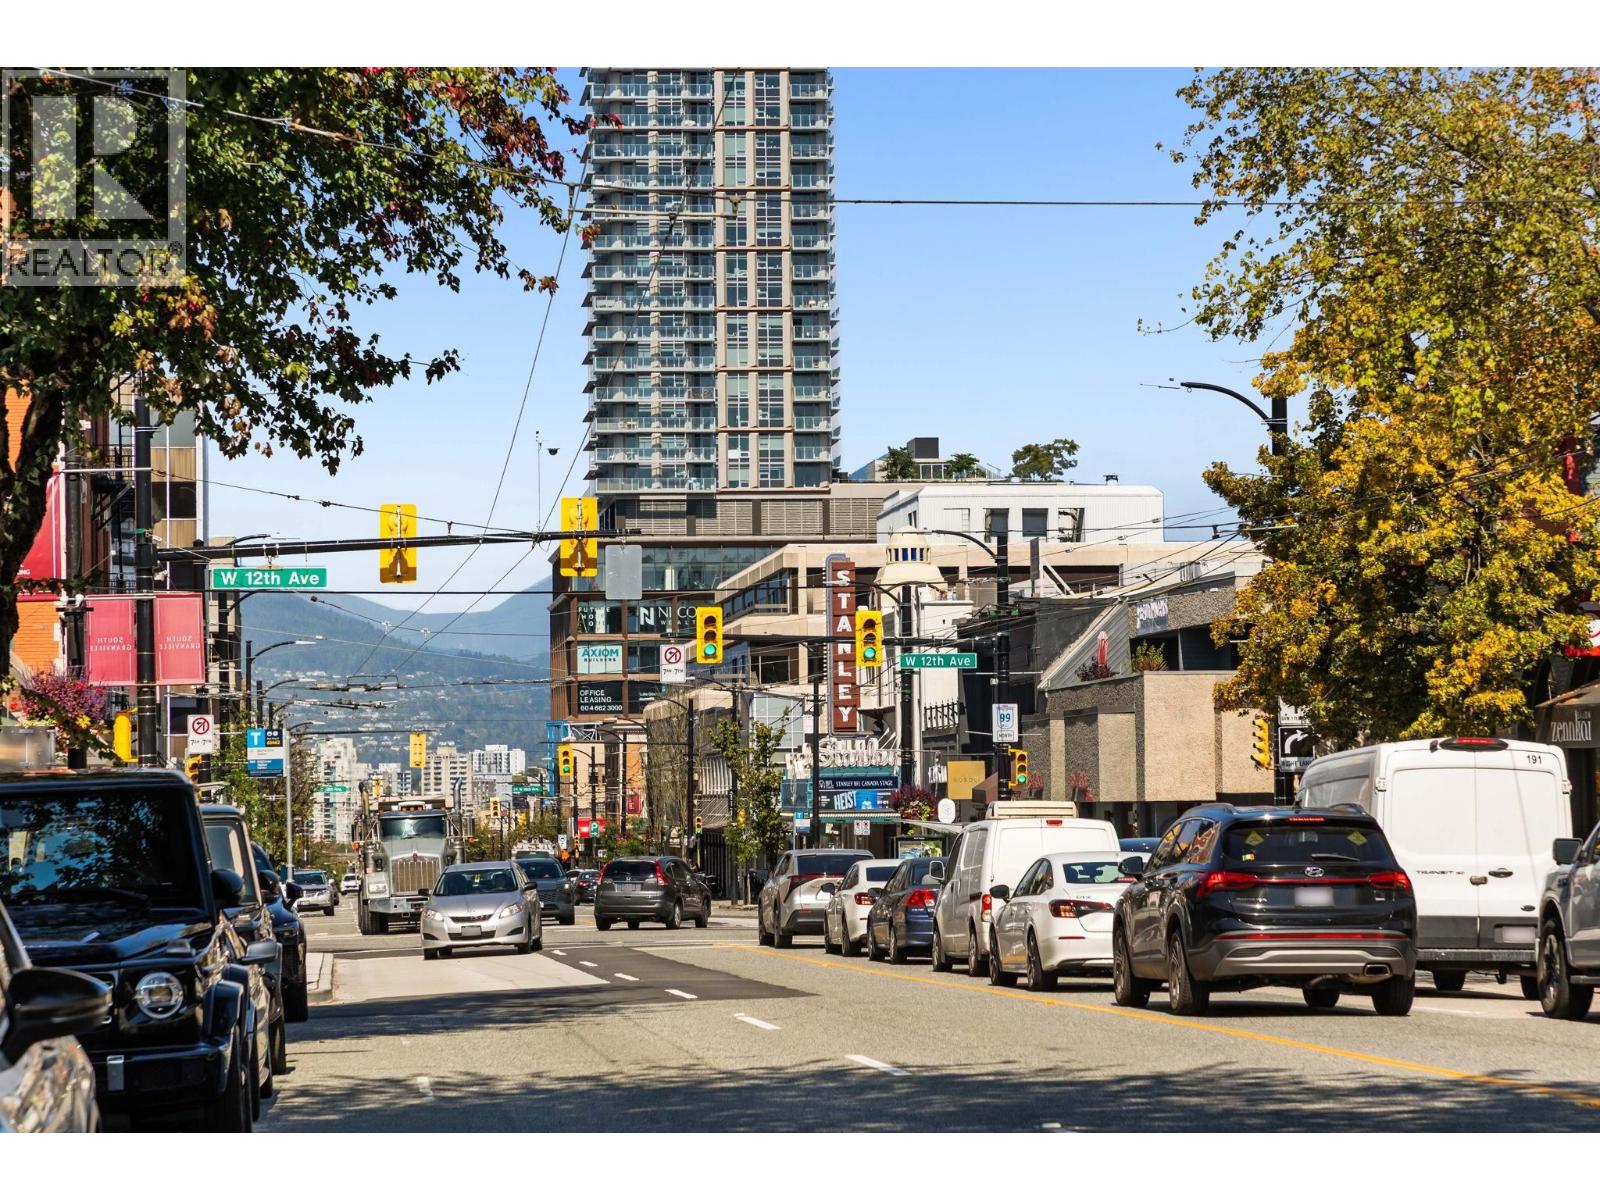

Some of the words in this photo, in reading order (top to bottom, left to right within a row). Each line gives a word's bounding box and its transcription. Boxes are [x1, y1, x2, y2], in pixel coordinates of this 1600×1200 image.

[220, 571, 237, 585] W
[245, 571, 281, 585] 12th
[288, 571, 320, 585] Ave
[836, 570, 853, 723] STANLEY
[581, 647, 619, 657] AXIOM
[905, 656, 916, 666] W
[921, 656, 944, 666] 12th
[949, 656, 971, 666] Ave
[1000, 713, 1011, 723] 99
[1527, 755, 1542, 765] 191
[833, 790, 858, 810] HEIST
